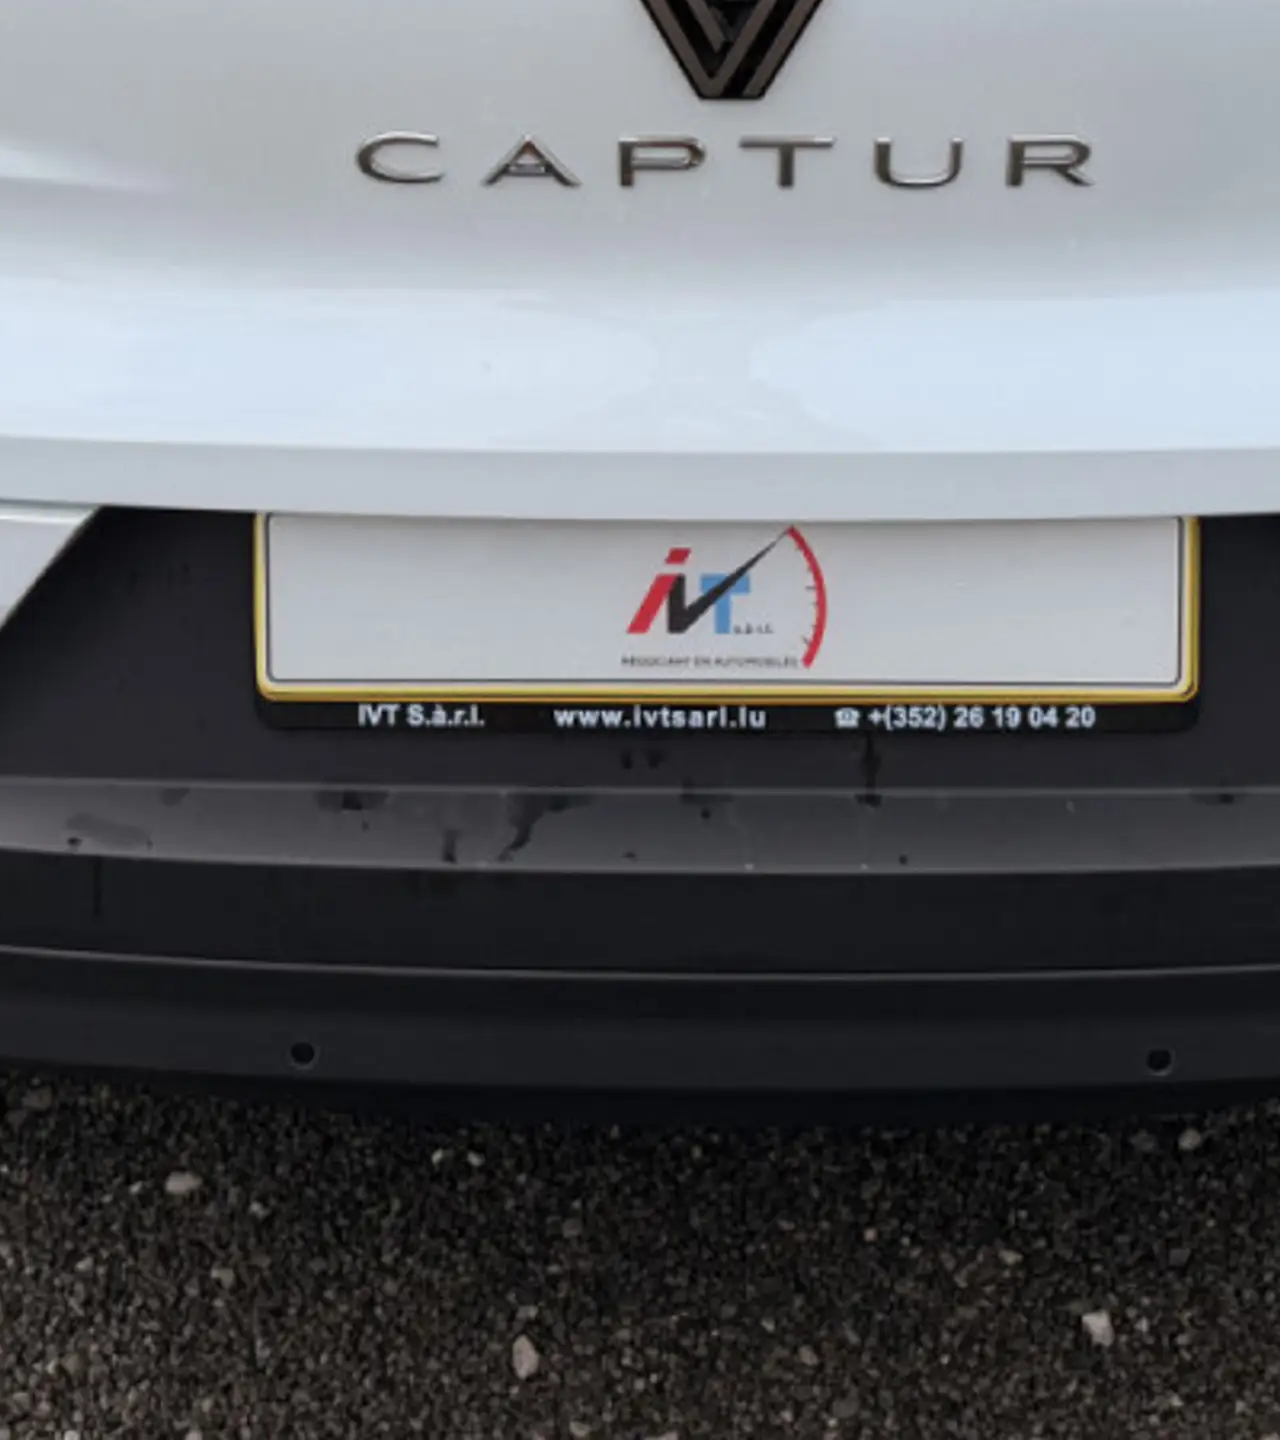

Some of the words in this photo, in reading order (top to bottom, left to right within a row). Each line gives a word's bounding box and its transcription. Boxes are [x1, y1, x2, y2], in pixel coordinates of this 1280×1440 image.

[354, 130, 1096, 190] CAPTUR
[358, 703, 401, 727] IVT
[554, 704, 767, 729] www.ivtsarl.lu
[867, 704, 947, 731] +(352)
[952, 705, 985, 728] 26
[991, 705, 1021, 728] 19
[1027, 705, 1059, 728] 04
[1065, 705, 1097, 728] 20
